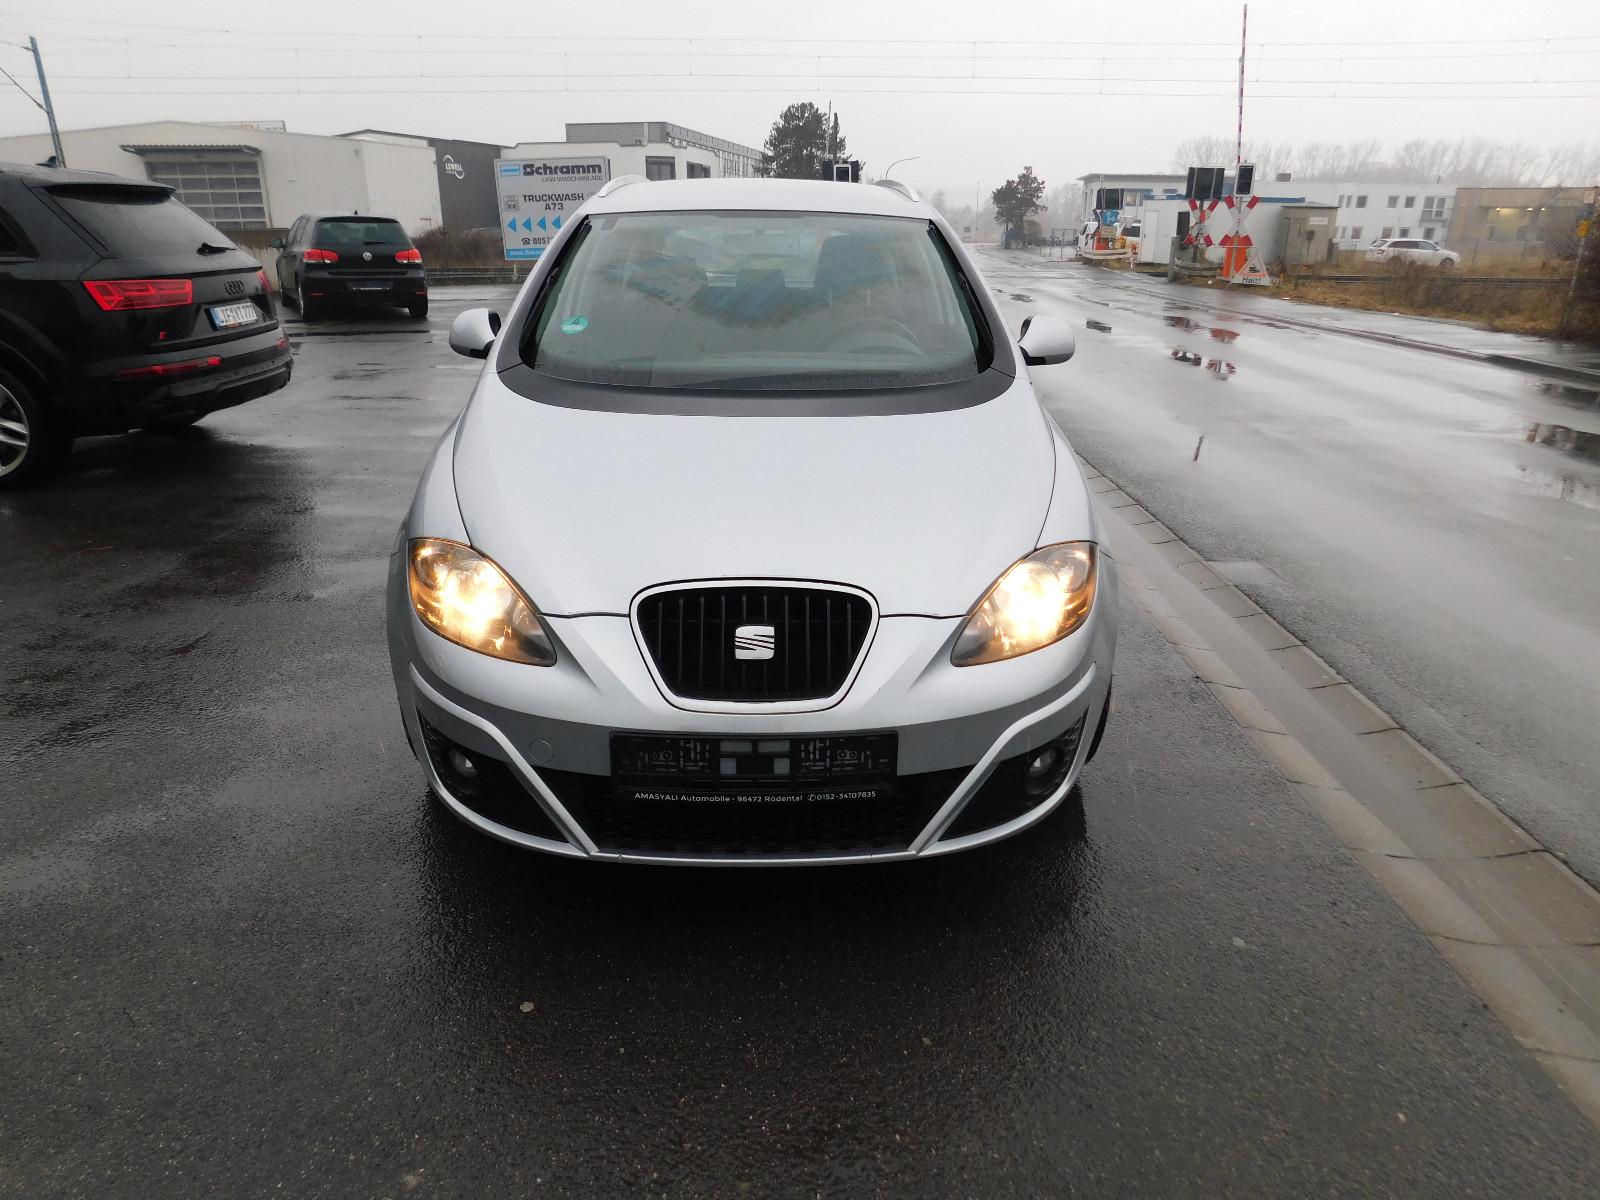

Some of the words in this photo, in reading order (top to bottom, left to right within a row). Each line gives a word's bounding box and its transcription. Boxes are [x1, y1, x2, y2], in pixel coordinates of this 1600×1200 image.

[522, 163, 602, 176] Schramm
[522, 193, 584, 203] TRUCKWASH
[545, 203, 564, 211] A73
[533, 237, 554, 245] 0957
[1242, 276, 1261, 284] Halt!
[634, 793, 679, 801] AMASYALI
